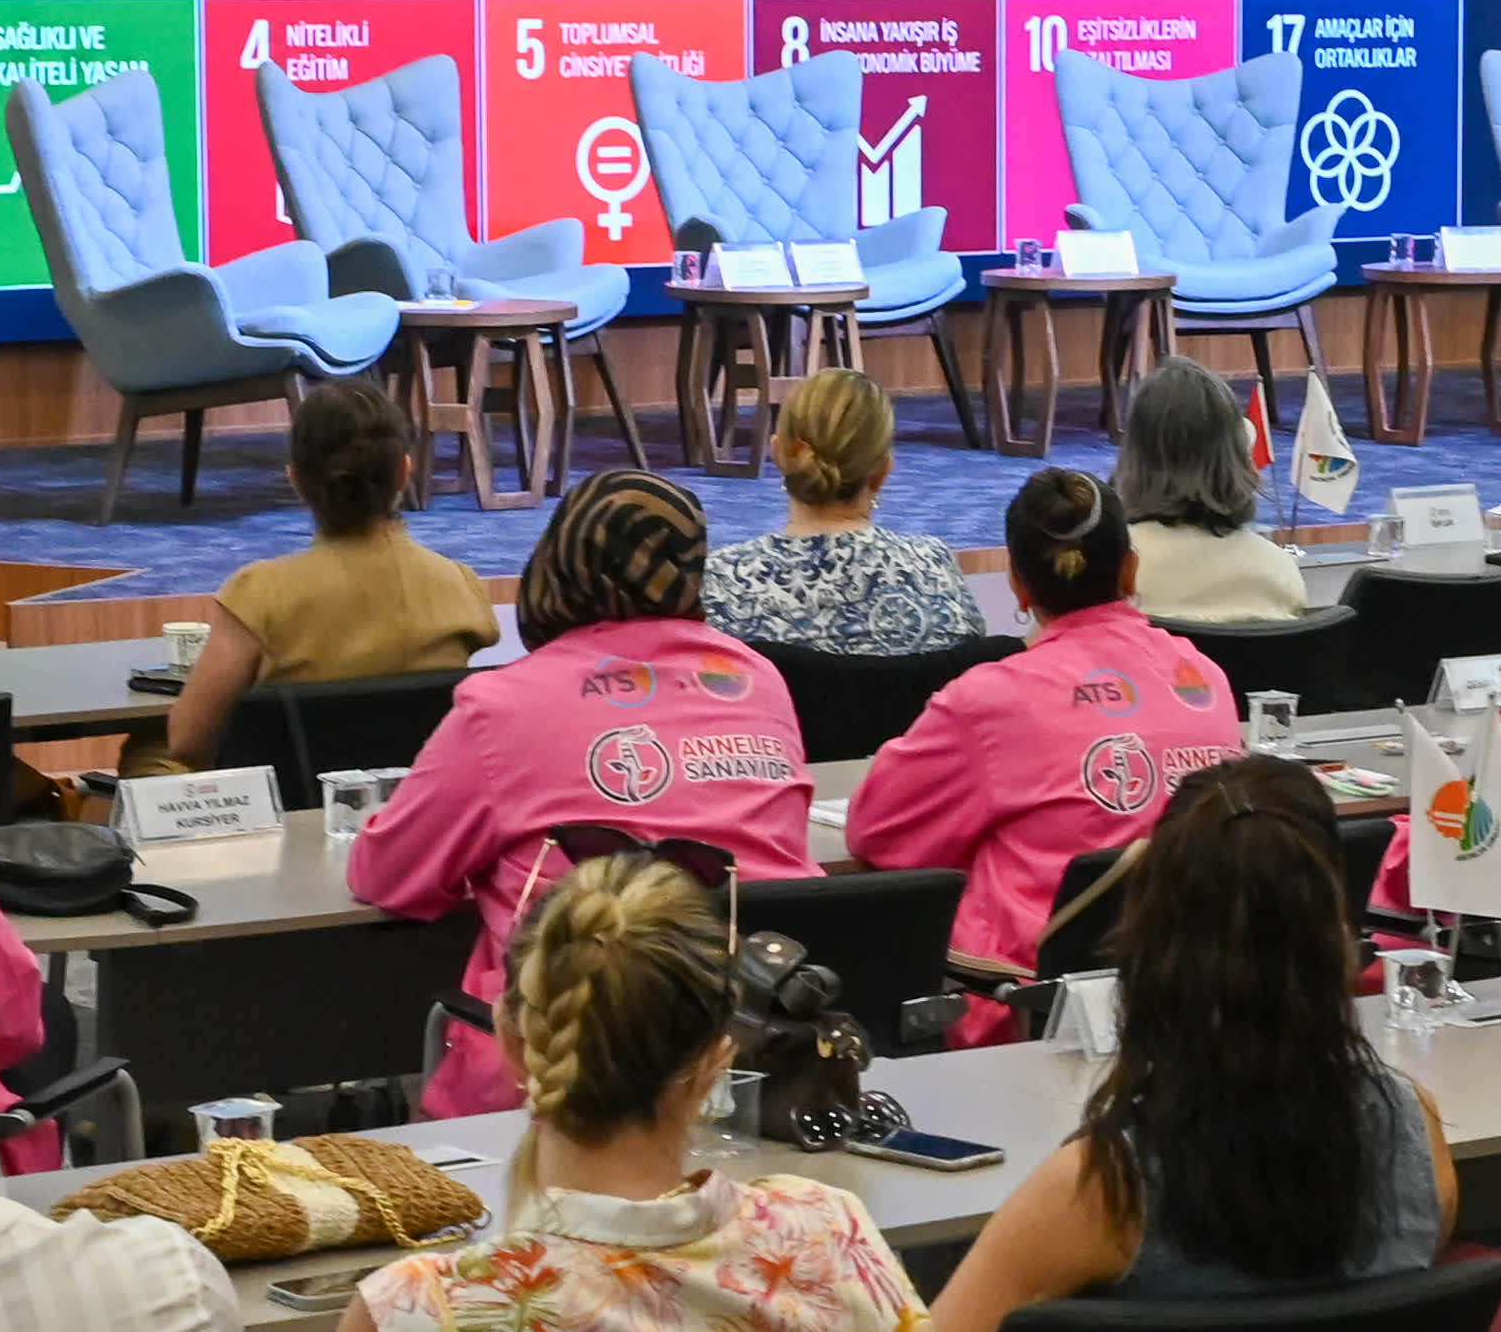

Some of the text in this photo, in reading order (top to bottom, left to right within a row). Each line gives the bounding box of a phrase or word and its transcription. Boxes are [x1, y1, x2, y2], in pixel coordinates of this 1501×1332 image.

[79, 26, 105, 50] VE
[287, 20, 370, 47] NİTELİKLİ
[559, 23, 660, 44] TOPLUMSAL
[781, 16, 811, 70] 8
[820, 17, 959, 47] İNSANA YAKIŞIR İŞ
[1077, 16, 1197, 46] EŞİTSİZLİKLERİN
[1265, 14, 1306, 55] 17
[1314, 14, 1414, 43] AMAÇLAR İÇİN
[239, 19, 270, 70] 4
[515, 18, 544, 80] 5
[1023, 15, 1067, 72] 10
[1315, 47, 1417, 69] ORTAKLIKLAR
[287, 53, 349, 80] EĞİTİM
[920, 48, 981, 73] BÜYÜME
